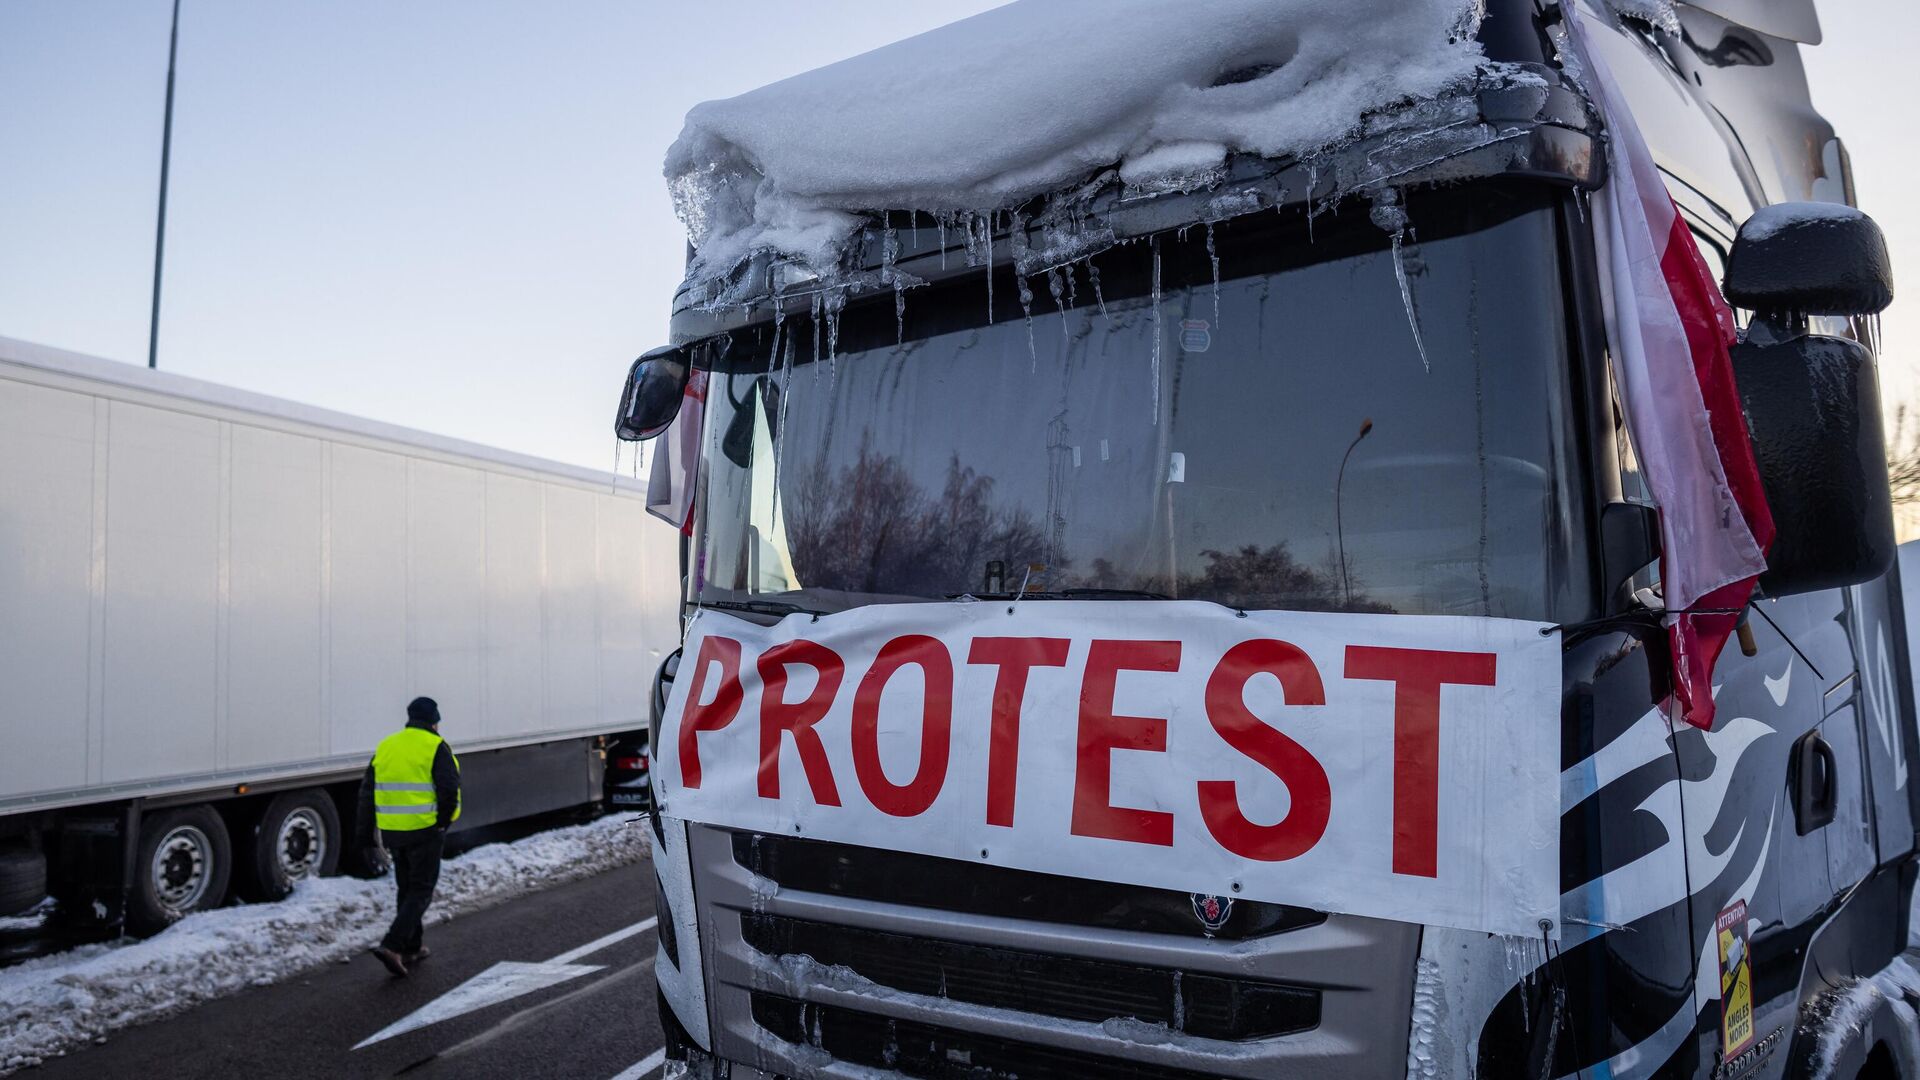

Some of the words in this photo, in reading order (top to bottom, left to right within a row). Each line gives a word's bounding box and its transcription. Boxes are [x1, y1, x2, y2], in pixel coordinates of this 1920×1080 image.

[678, 634, 1497, 878] PROTEST
[1718, 903, 1746, 930] ATTENTION
[1727, 1003, 1749, 1030] ANGLES
[1729, 1020, 1749, 1046] MORTS
[1727, 1047, 1757, 1077] CROWN
[1757, 1026, 1785, 1055] EDITION
